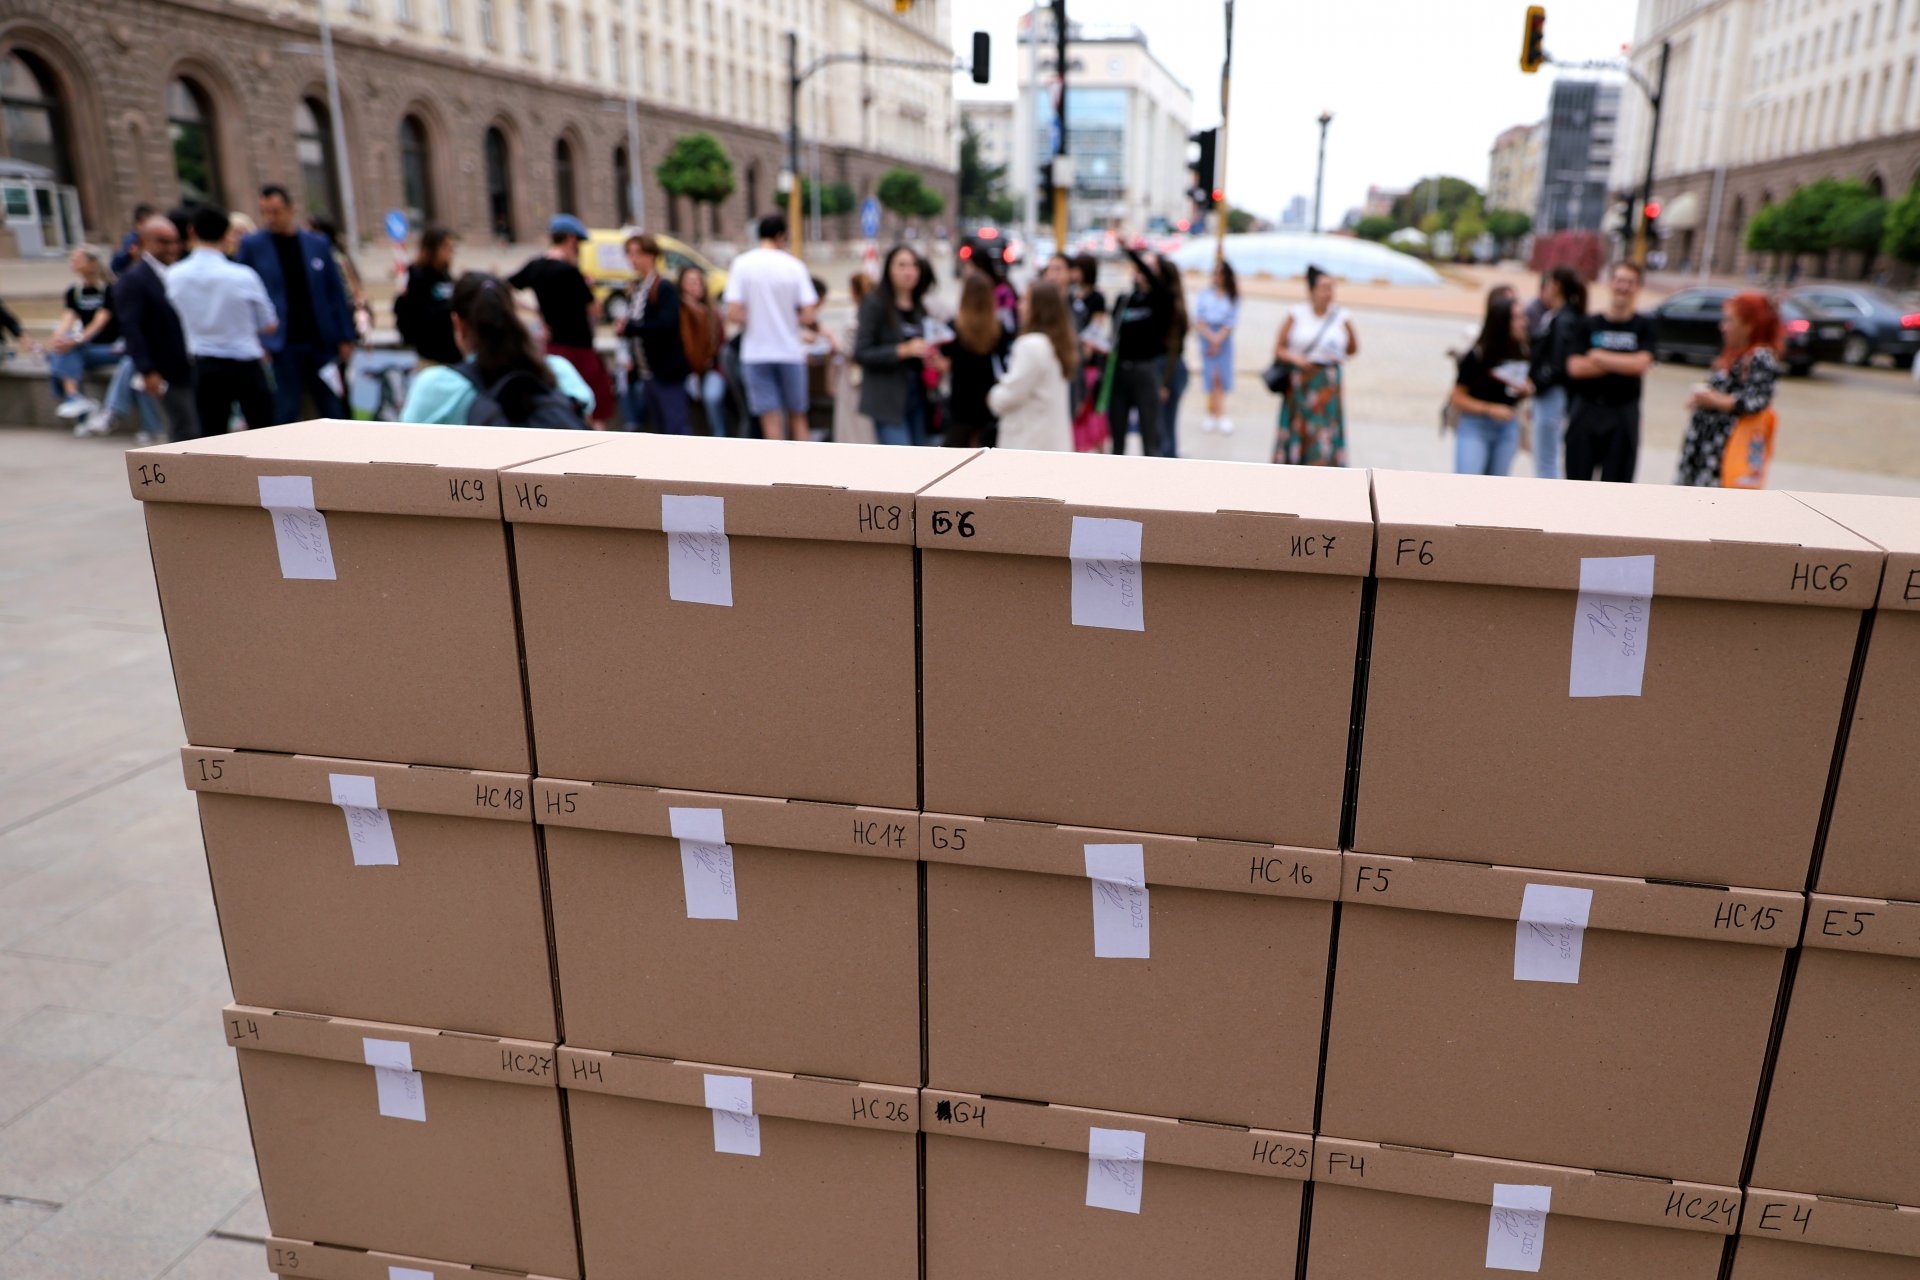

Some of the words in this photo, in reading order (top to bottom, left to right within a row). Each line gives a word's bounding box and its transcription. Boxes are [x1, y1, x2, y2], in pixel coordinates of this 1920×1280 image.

[138, 463, 166, 486] I6
[515, 482, 548, 511] H6
[859, 503, 902, 534] HC8
[1396, 538, 1434, 566] F6
[1791, 562, 1852, 592] HC6
[198, 758, 226, 781] I5
[476, 783, 525, 810] HC18
[547, 790, 579, 815] H5
[854, 819, 907, 849] HC17
[932, 826, 968, 851] G5
[1356, 866, 1393, 893] F5
[1715, 902, 1784, 931] HC15
[1823, 909, 1876, 936] E5
[231, 1019, 261, 1041] I4
[501, 1051, 552, 1076] HC27
[572, 1058, 603, 1083] H4
[852, 1096, 910, 1122] HC26
[953, 1101, 986, 1129] G4
[1252, 1140, 1309, 1169] HC25
[1328, 1152, 1365, 1178] F4
[1664, 1190, 1738, 1226] HC24
[1758, 1203, 1813, 1235] E4
[274, 1249, 300, 1269] I3
